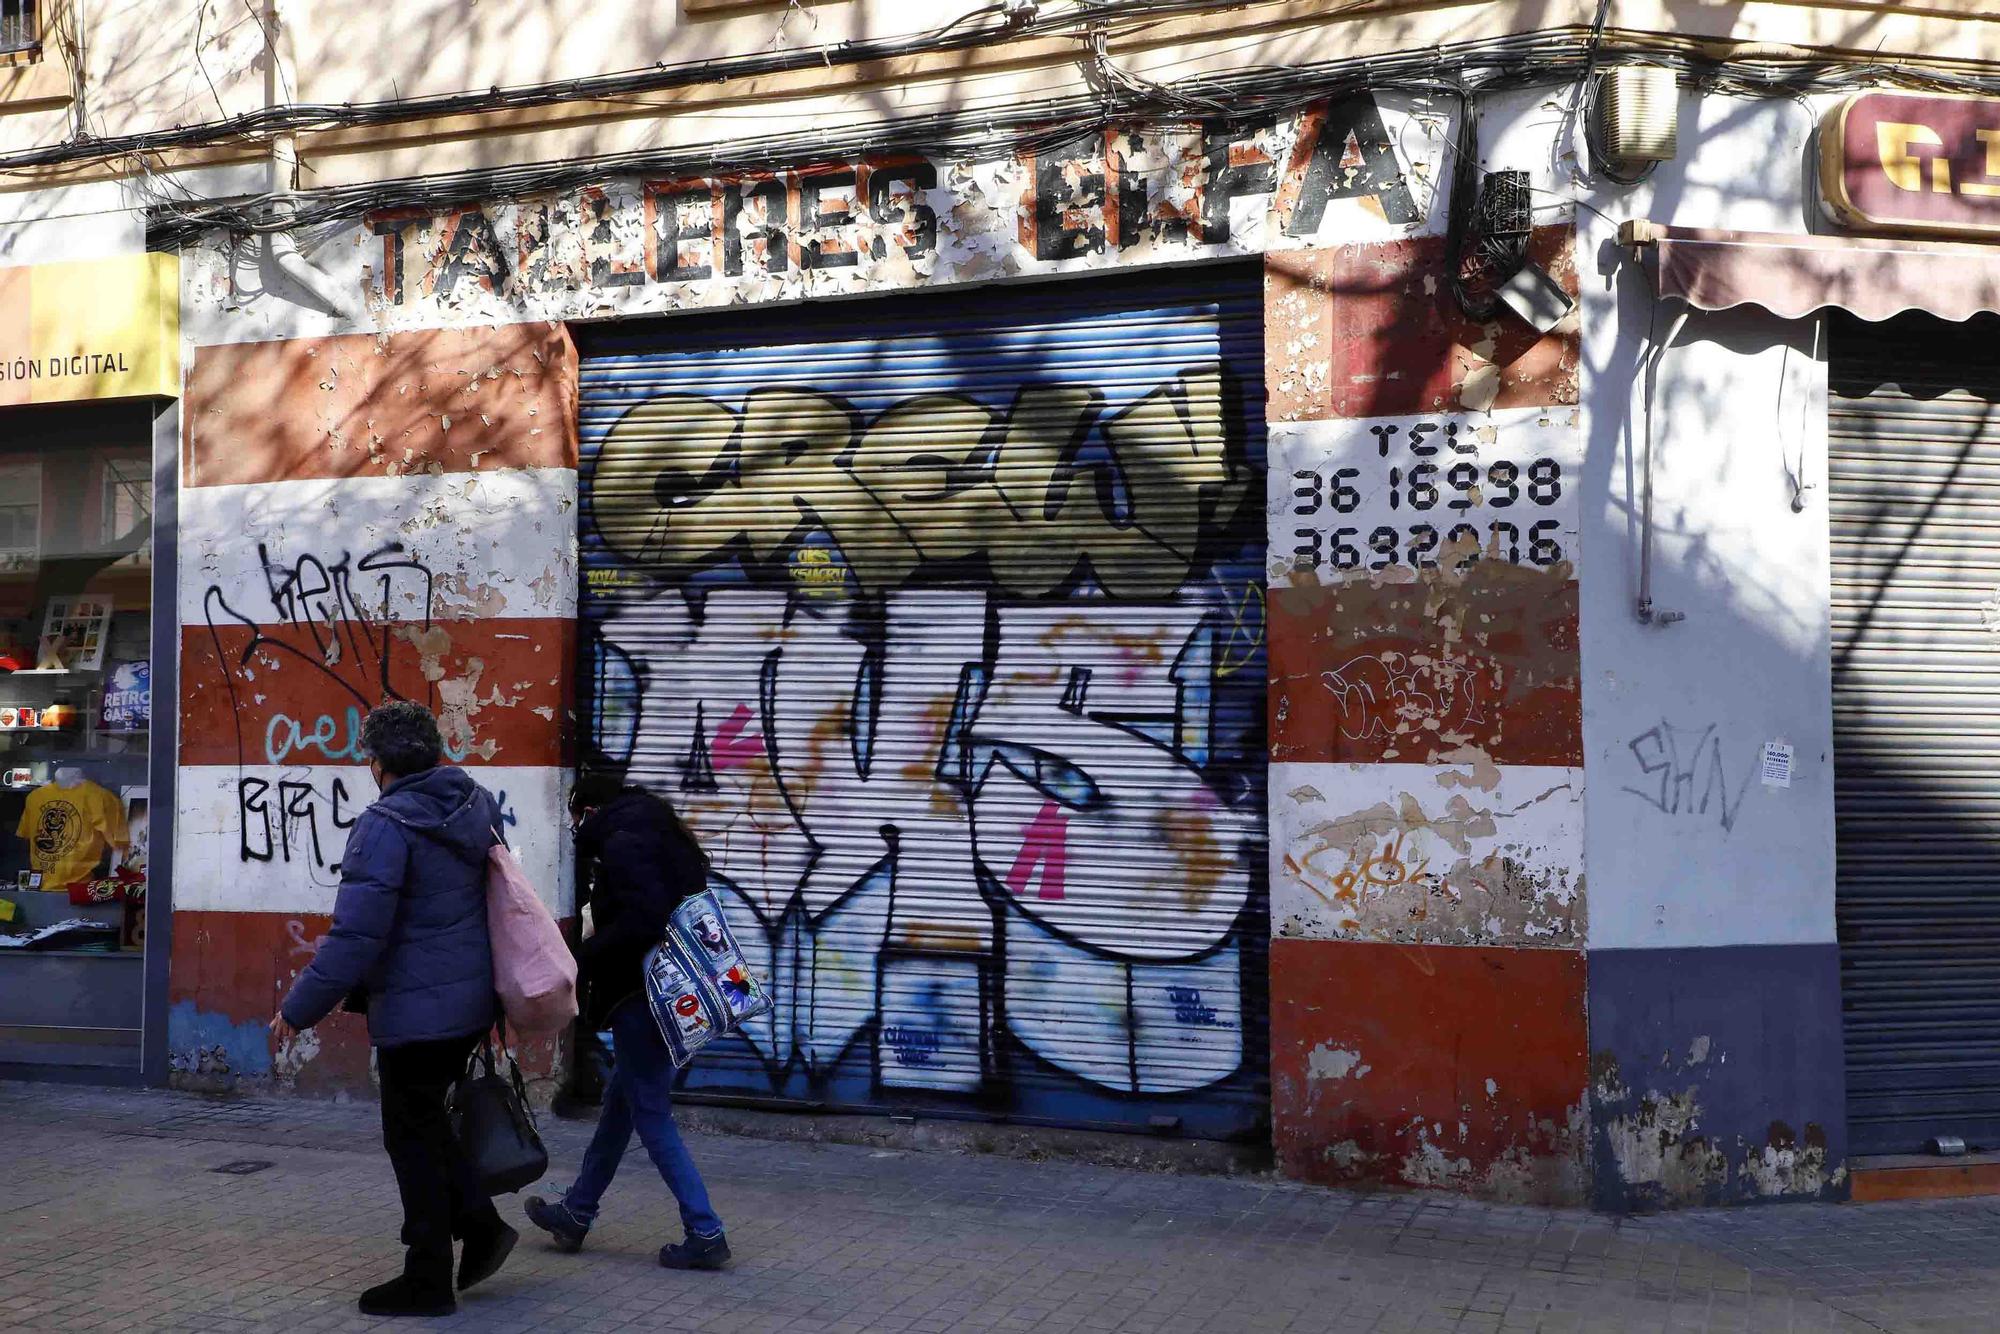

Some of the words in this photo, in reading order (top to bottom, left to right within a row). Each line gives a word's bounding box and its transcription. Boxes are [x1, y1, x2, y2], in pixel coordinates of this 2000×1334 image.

[50, 352, 129, 377] DIGITAL
[1293, 467, 1361, 515] 36
[1388, 457, 1562, 511] 16998
